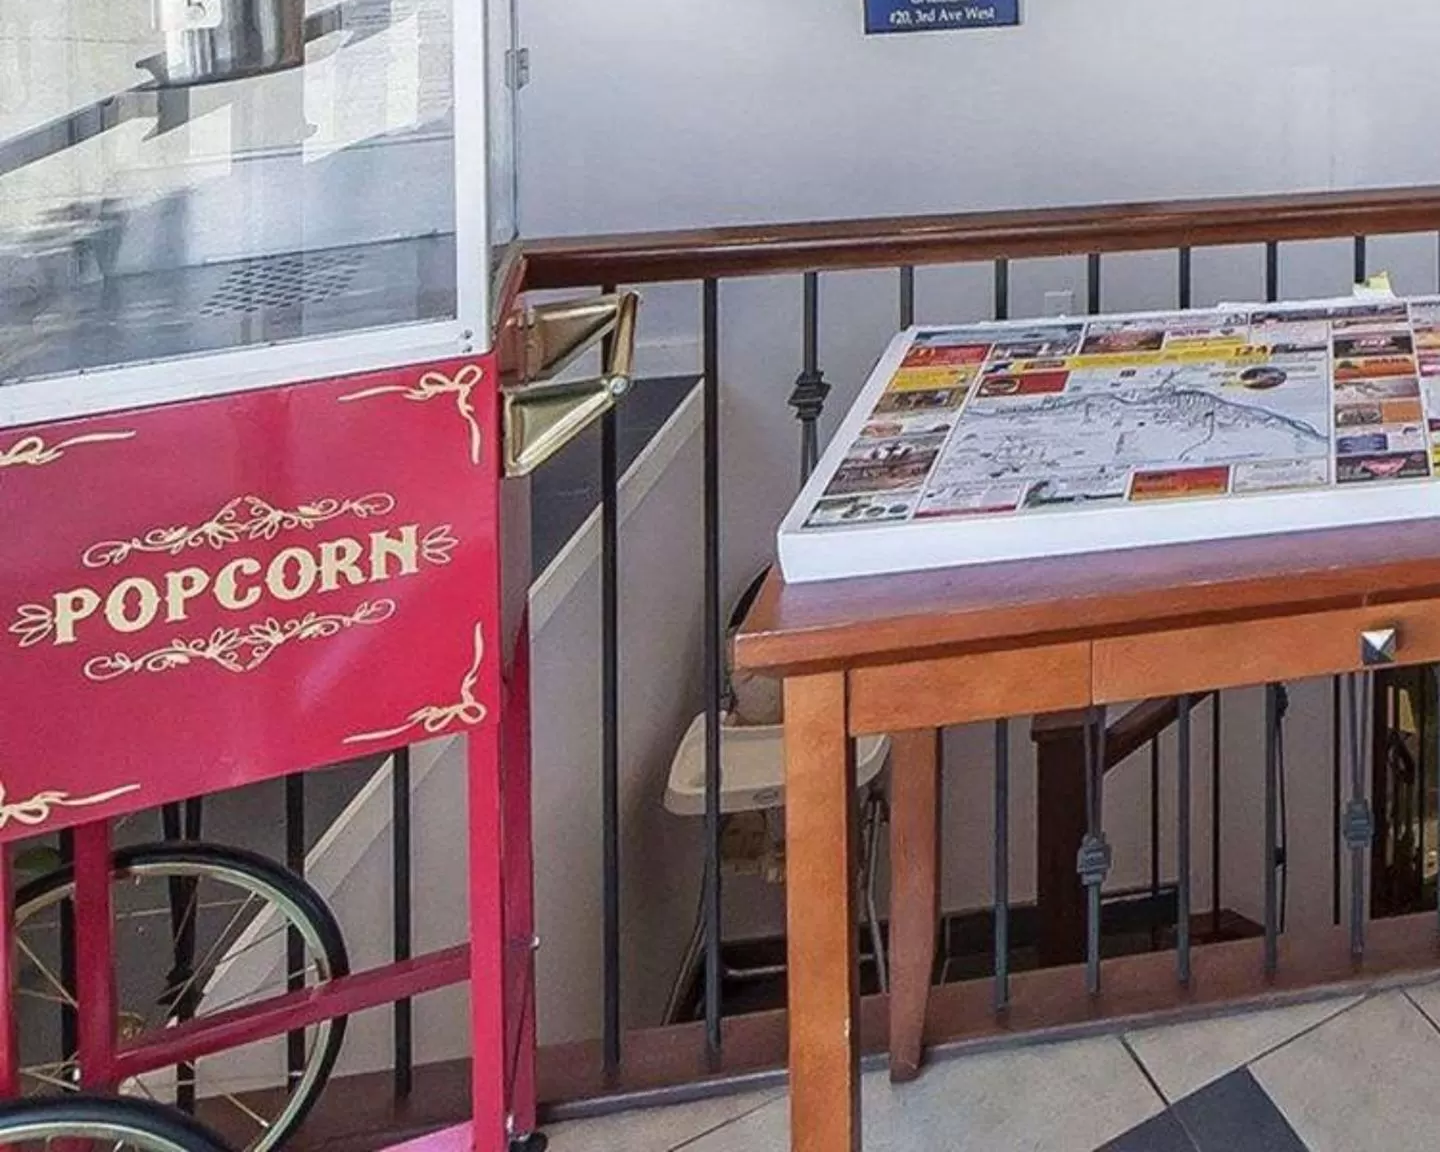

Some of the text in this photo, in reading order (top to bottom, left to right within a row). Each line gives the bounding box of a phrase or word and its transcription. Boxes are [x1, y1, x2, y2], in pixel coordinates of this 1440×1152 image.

[915, 8, 936, 23] 3rd
[938, 8, 962, 22] Ave
[964, 7, 995, 20] West
[51, 523, 421, 644] POPCORN
